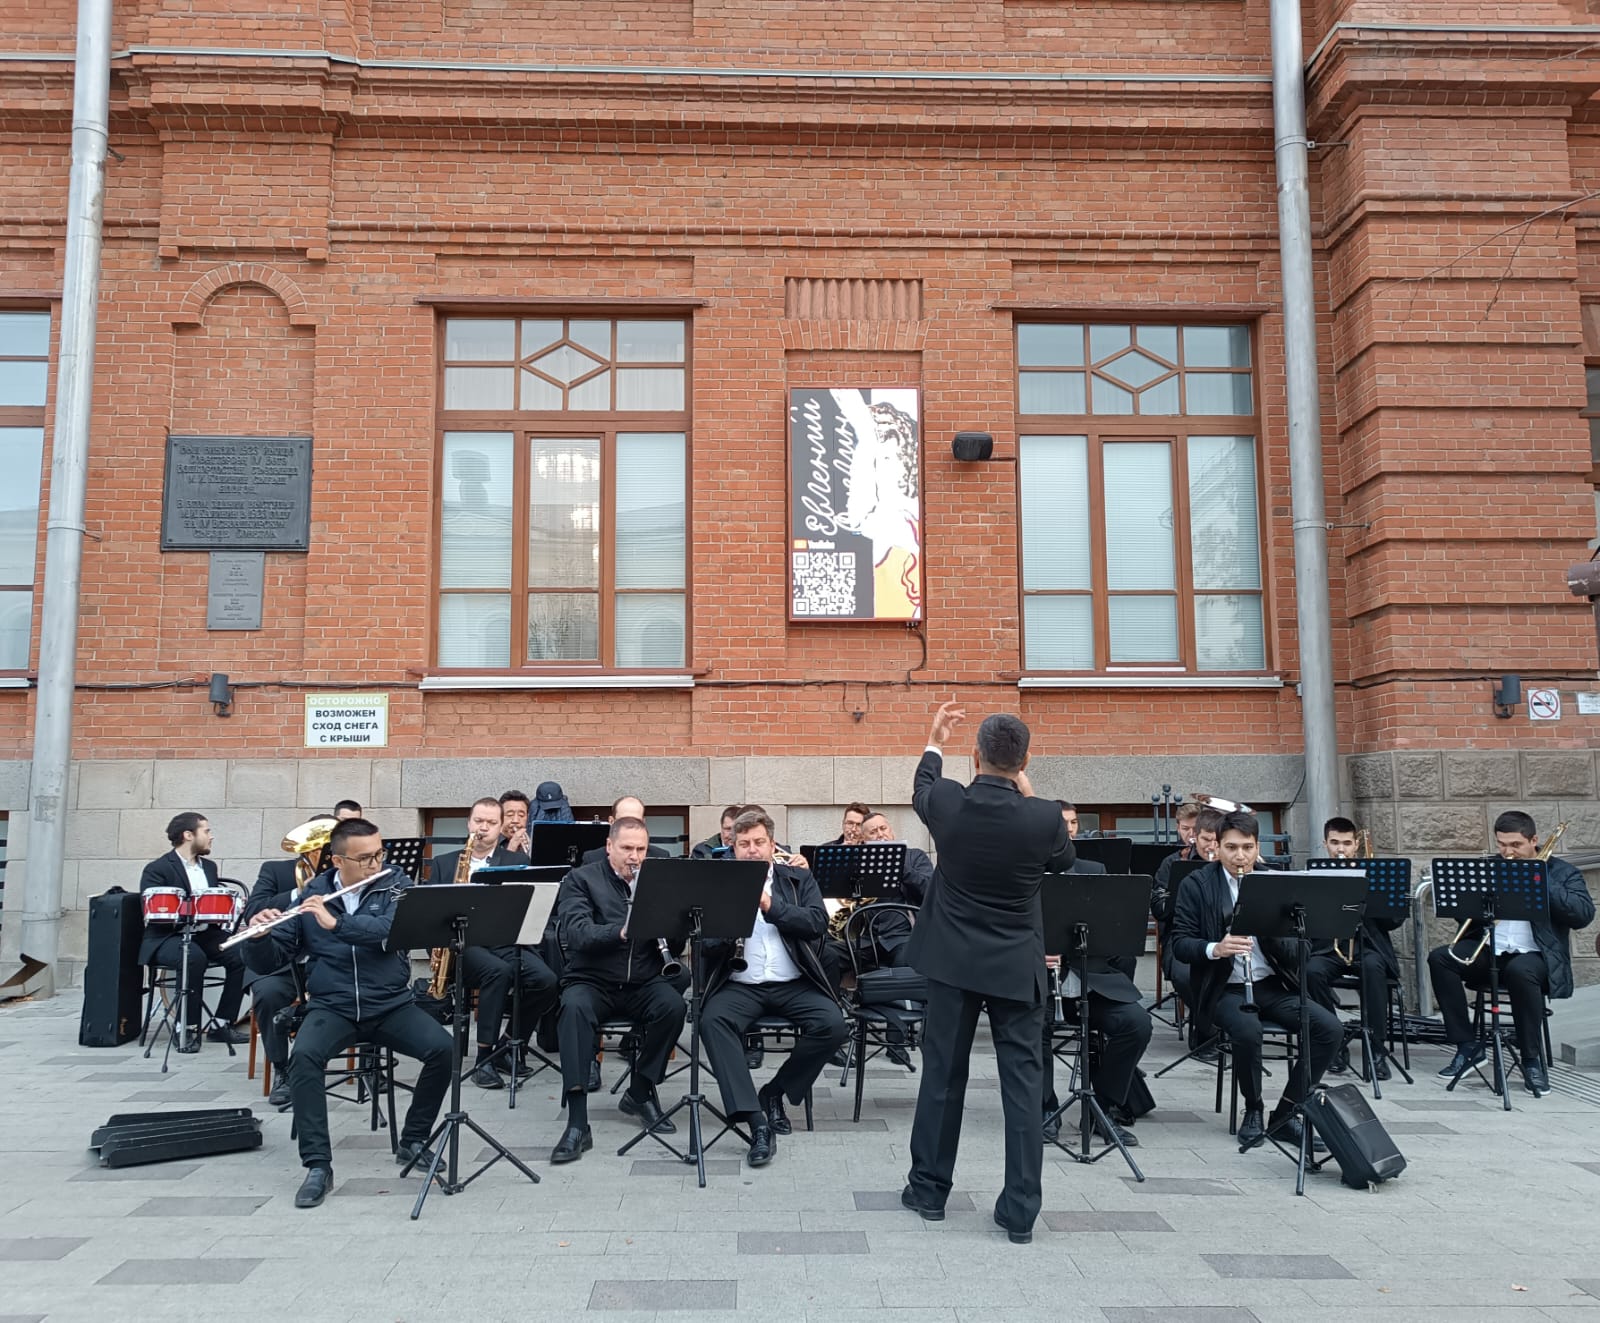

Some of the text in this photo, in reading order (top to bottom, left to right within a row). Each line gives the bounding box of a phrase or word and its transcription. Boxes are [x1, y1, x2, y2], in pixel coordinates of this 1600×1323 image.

[309, 696, 381, 705] ОСТОРОЖНО
[315, 709, 376, 718] ВОЗМОЖЕН
[312, 722, 378, 731] СХОД СНЕГА
[330, 734, 370, 742] КРЫШИ
